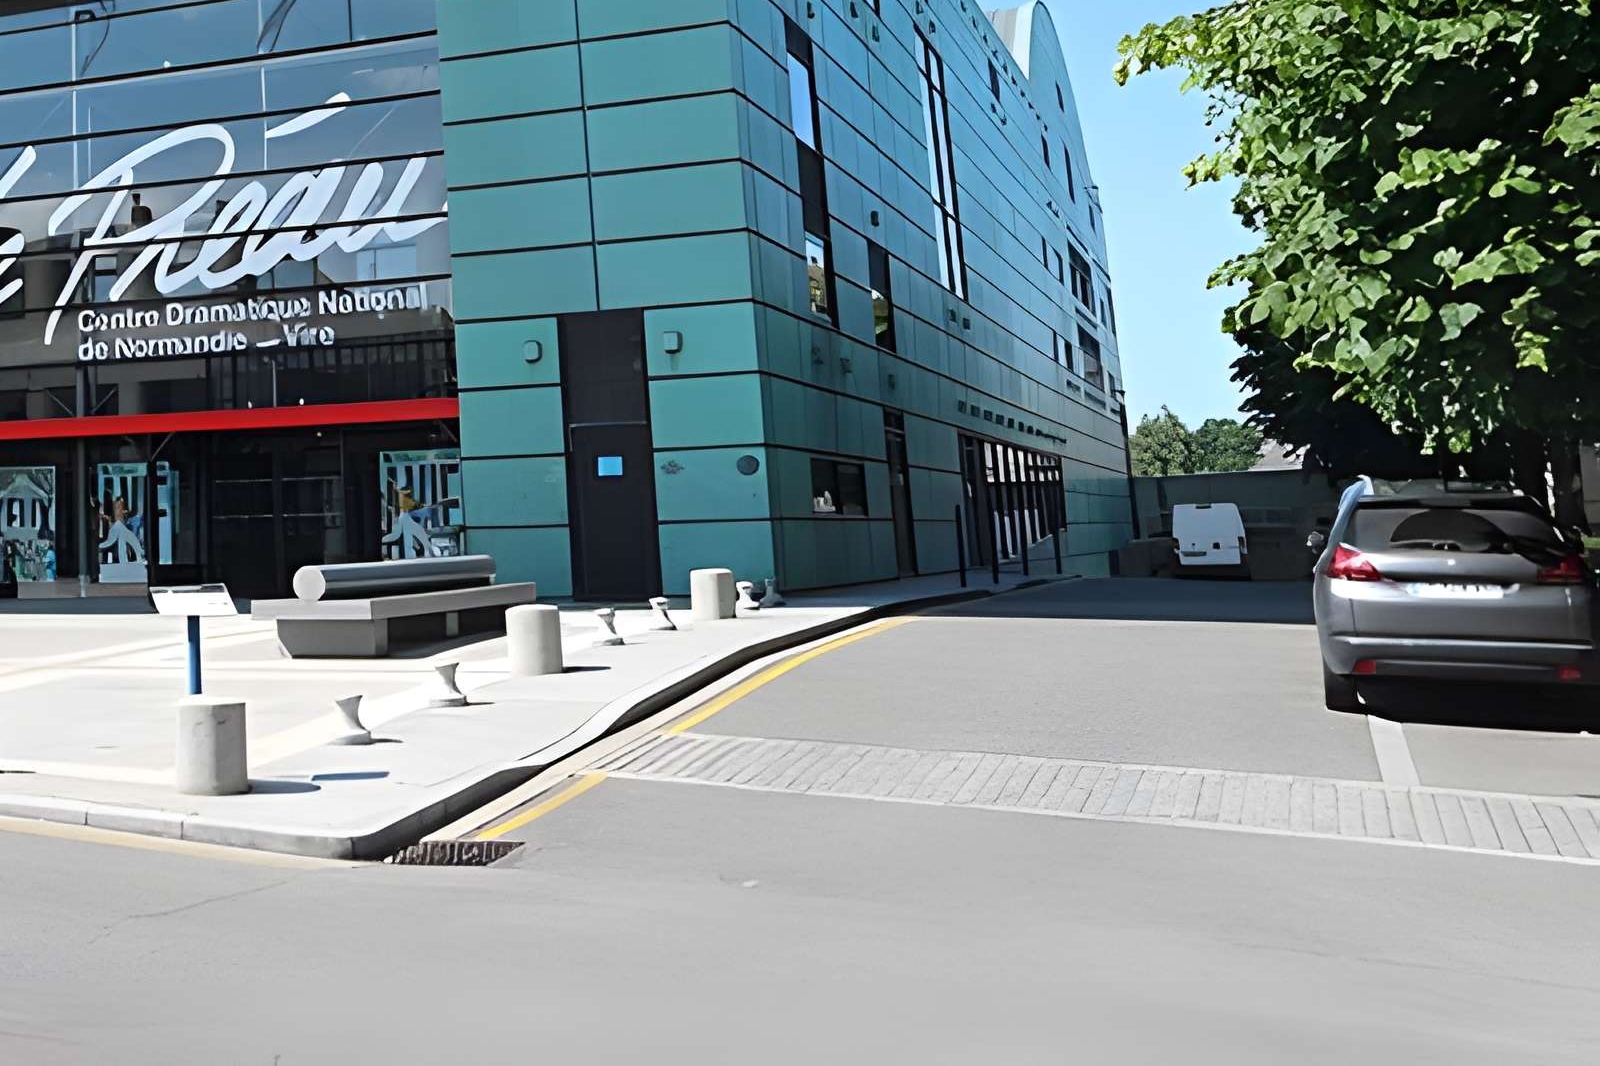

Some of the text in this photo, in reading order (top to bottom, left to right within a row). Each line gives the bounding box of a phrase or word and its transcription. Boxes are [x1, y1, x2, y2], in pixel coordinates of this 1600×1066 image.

[45, 92, 448, 346] Préau
[78, 284, 427, 332] Centre Dramatique National
[78, 336, 108, 361] de
[115, 331, 247, 358] Normandie
[282, 324, 335, 346] Vire
